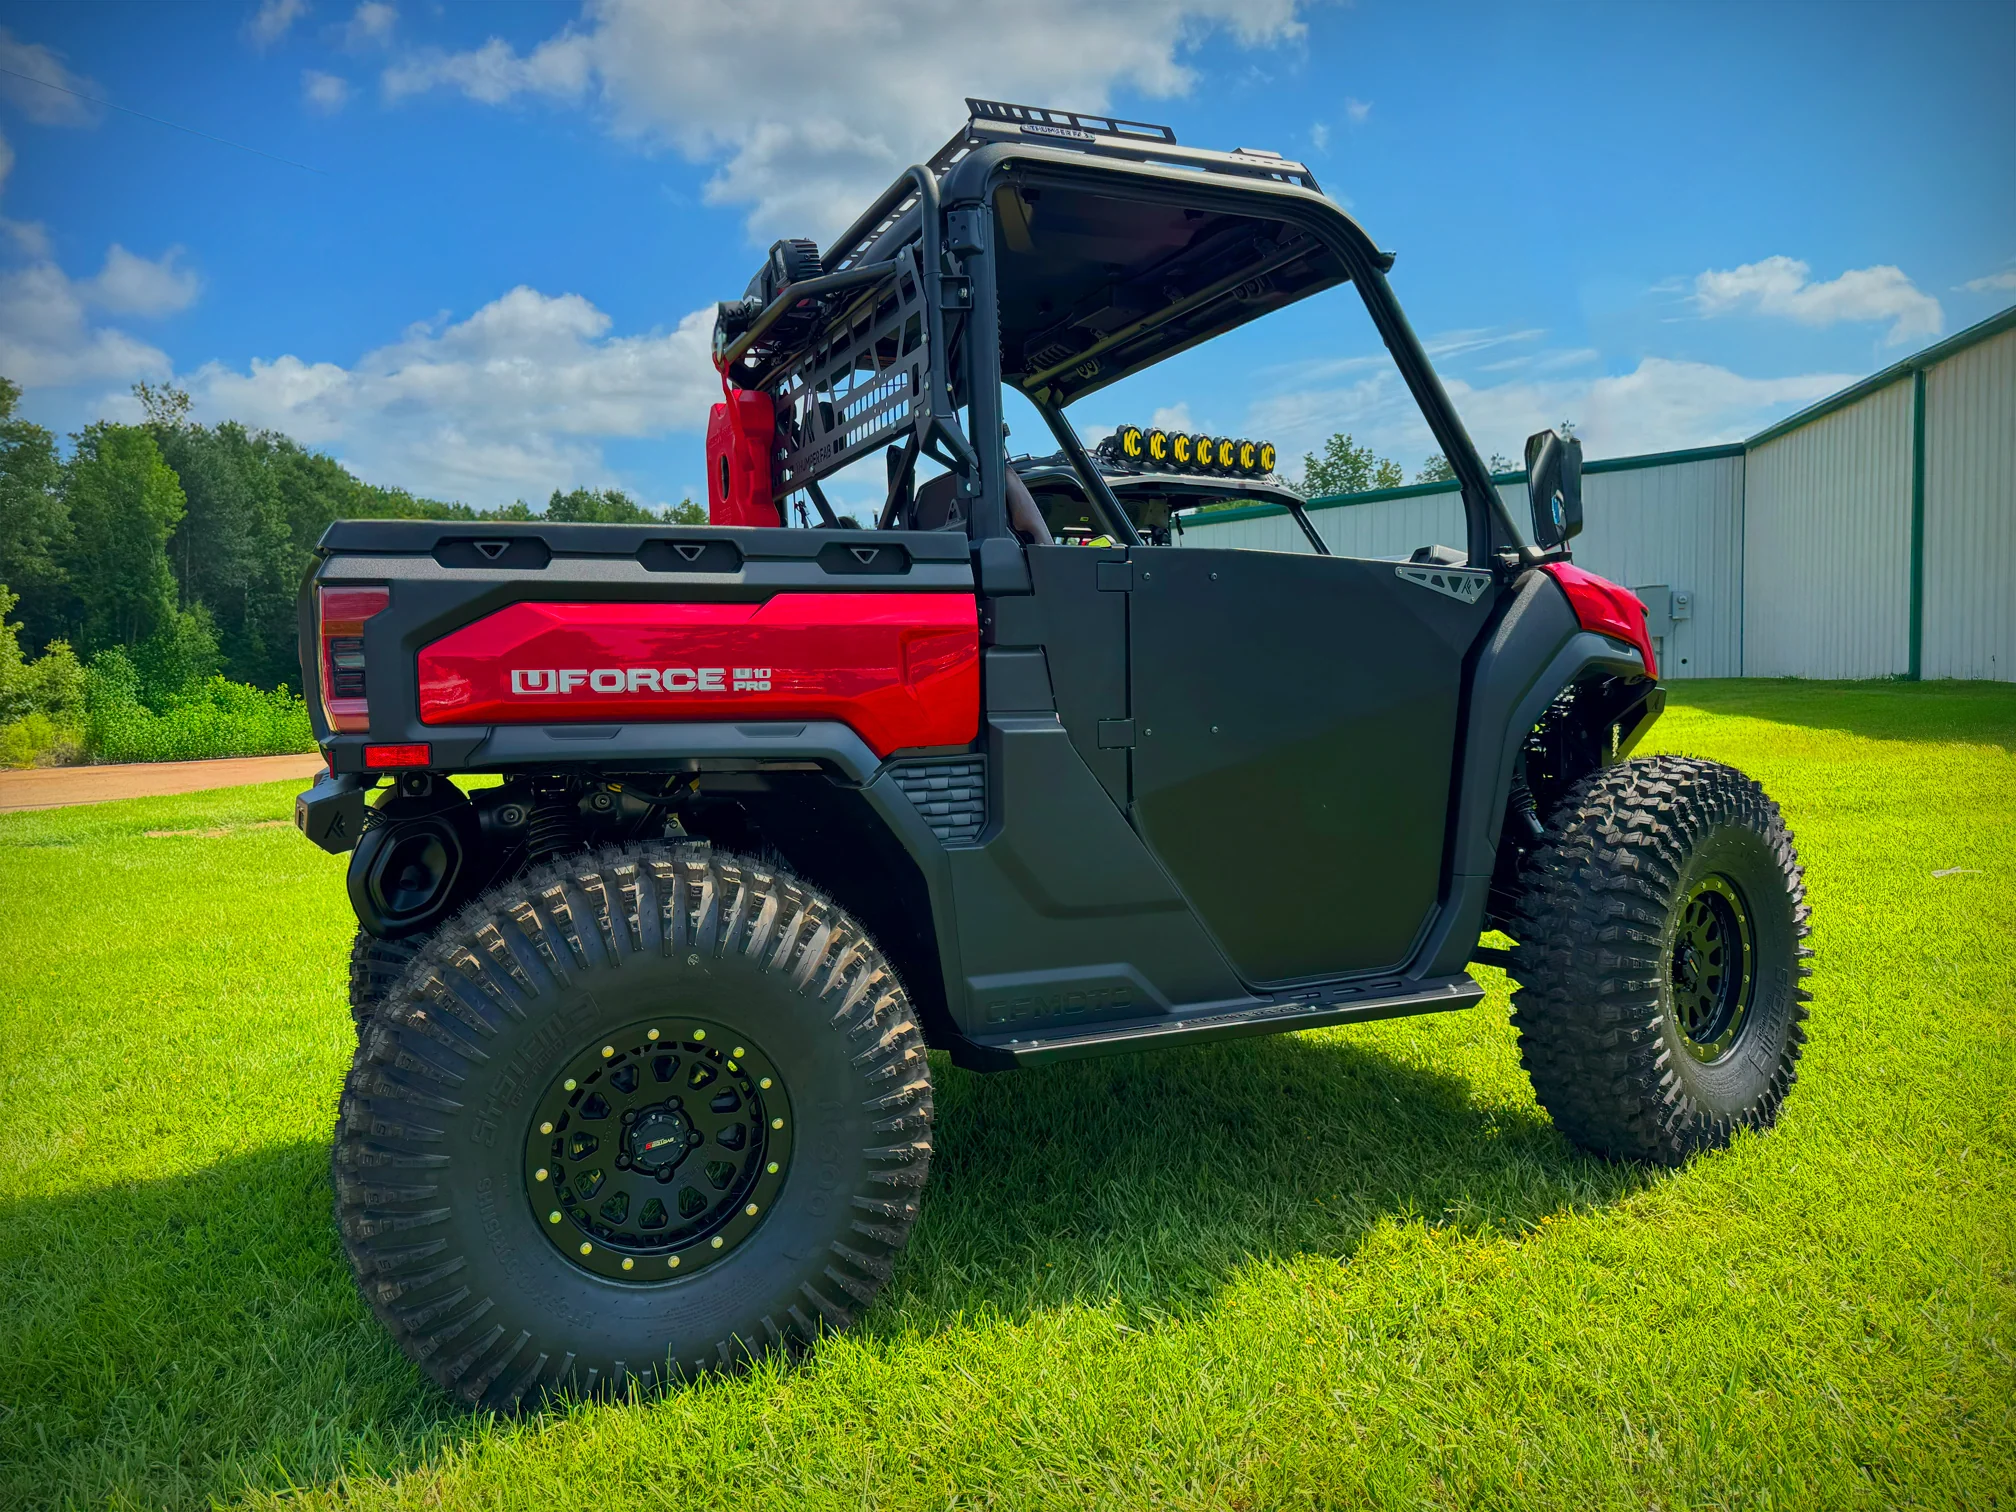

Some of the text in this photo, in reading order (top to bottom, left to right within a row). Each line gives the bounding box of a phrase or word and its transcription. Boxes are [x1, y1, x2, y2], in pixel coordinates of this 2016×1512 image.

[1123, 428, 1142, 457] KC
[1150, 432, 1167, 460] KC
[1174, 435, 1190, 463] KC
[1197, 438, 1213, 465] KC
[1219, 440, 1234, 467] KC
[1240, 442, 1255, 469] KC
[1261, 444, 1275, 471] KC
[733, 667, 772, 679] U10
[733, 681, 772, 692] PRO
[985, 985, 1134, 1025] CFMOTO
